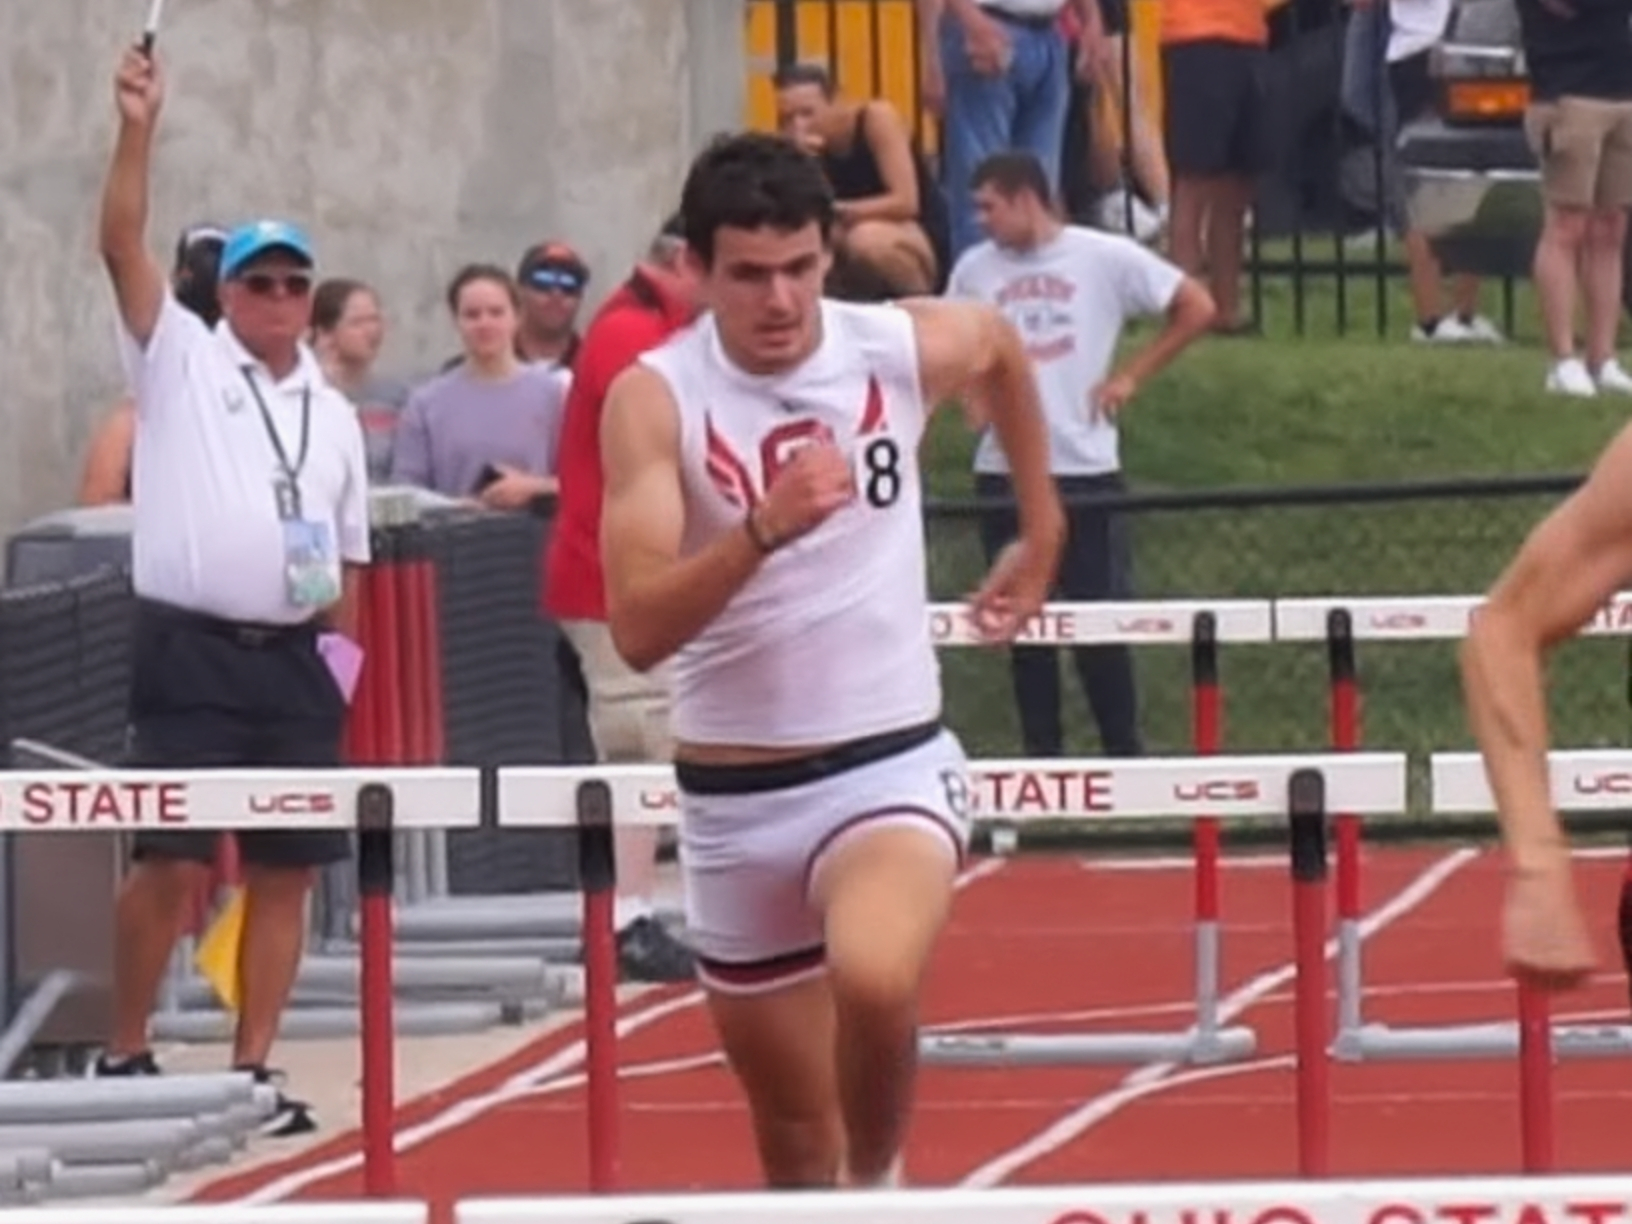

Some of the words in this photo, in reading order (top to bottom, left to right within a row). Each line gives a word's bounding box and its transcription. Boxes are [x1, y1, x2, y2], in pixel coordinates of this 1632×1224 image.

[865, 438, 900, 508] 8
[1174, 781, 1258, 801] UCS
[1574, 773, 1632, 794] UC
[23, 782, 188, 823] STATE
[248, 794, 335, 814] UCS
